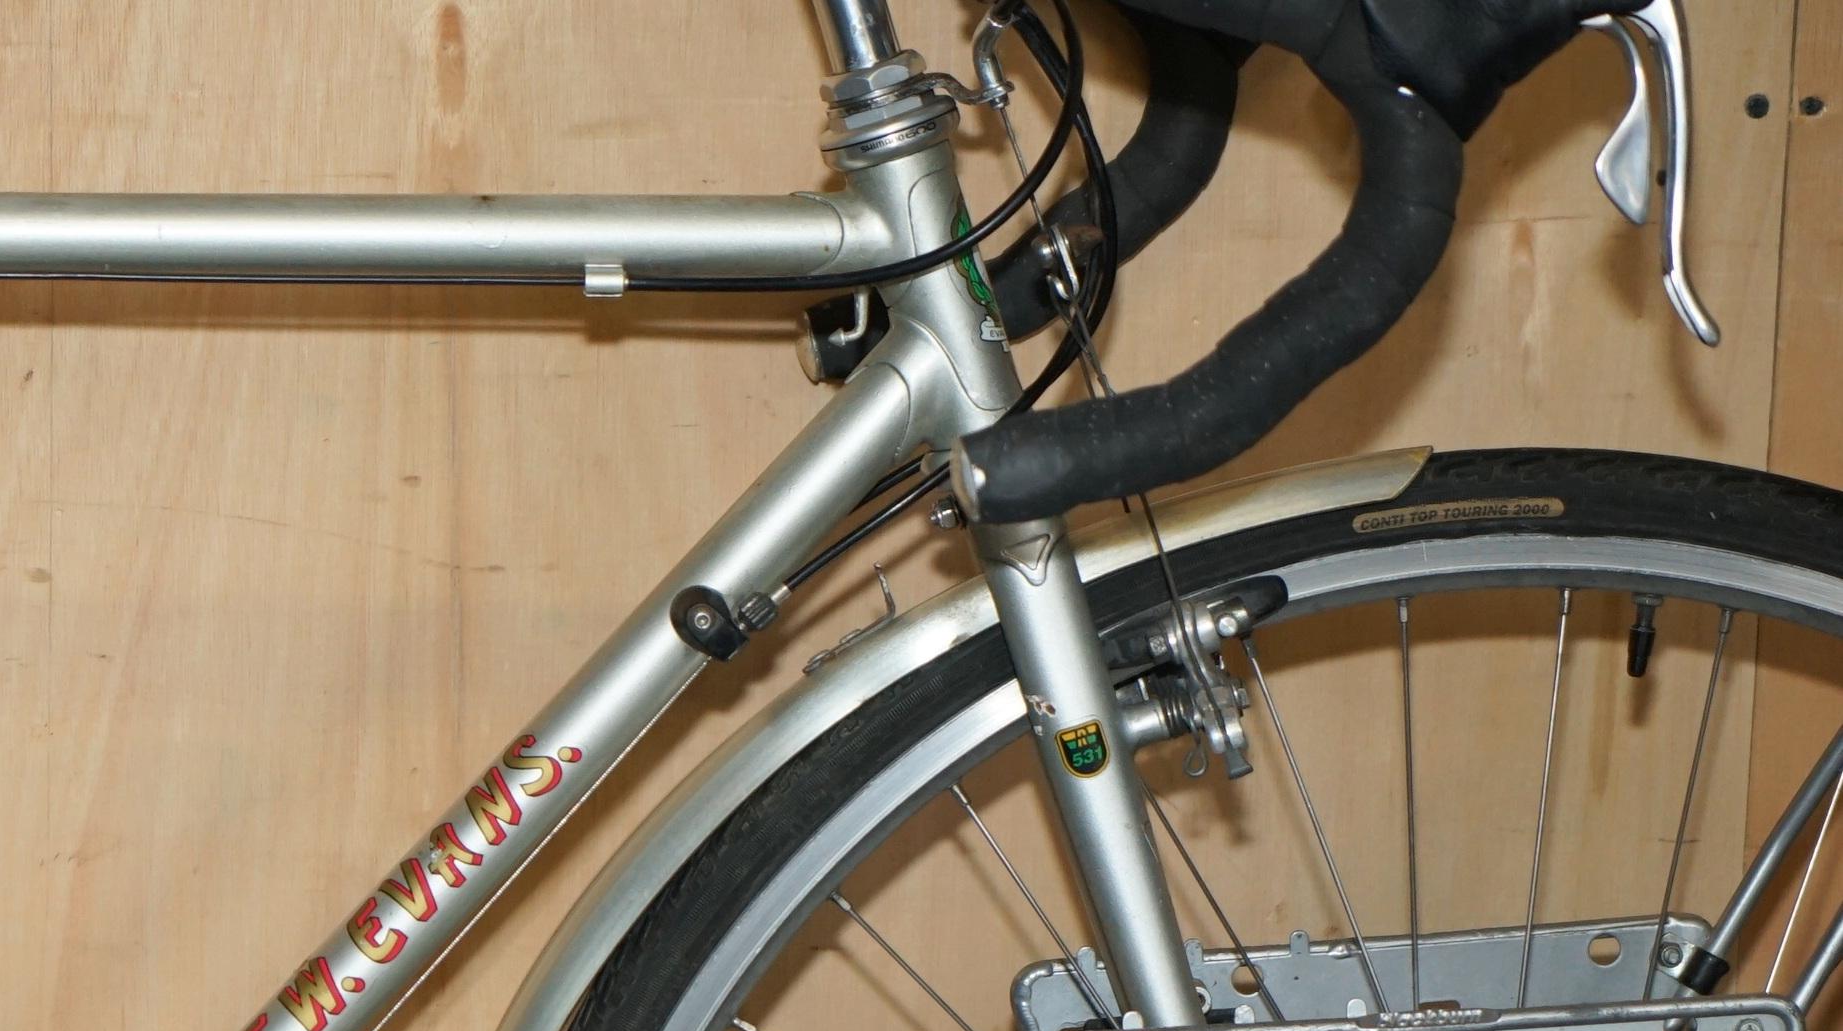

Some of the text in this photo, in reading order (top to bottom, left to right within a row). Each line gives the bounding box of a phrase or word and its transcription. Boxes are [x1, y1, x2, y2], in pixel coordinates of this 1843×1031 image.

[1360, 502, 1551, 531] CONTI TOP TOURING 2000
[1072, 745, 1103, 768] 531
